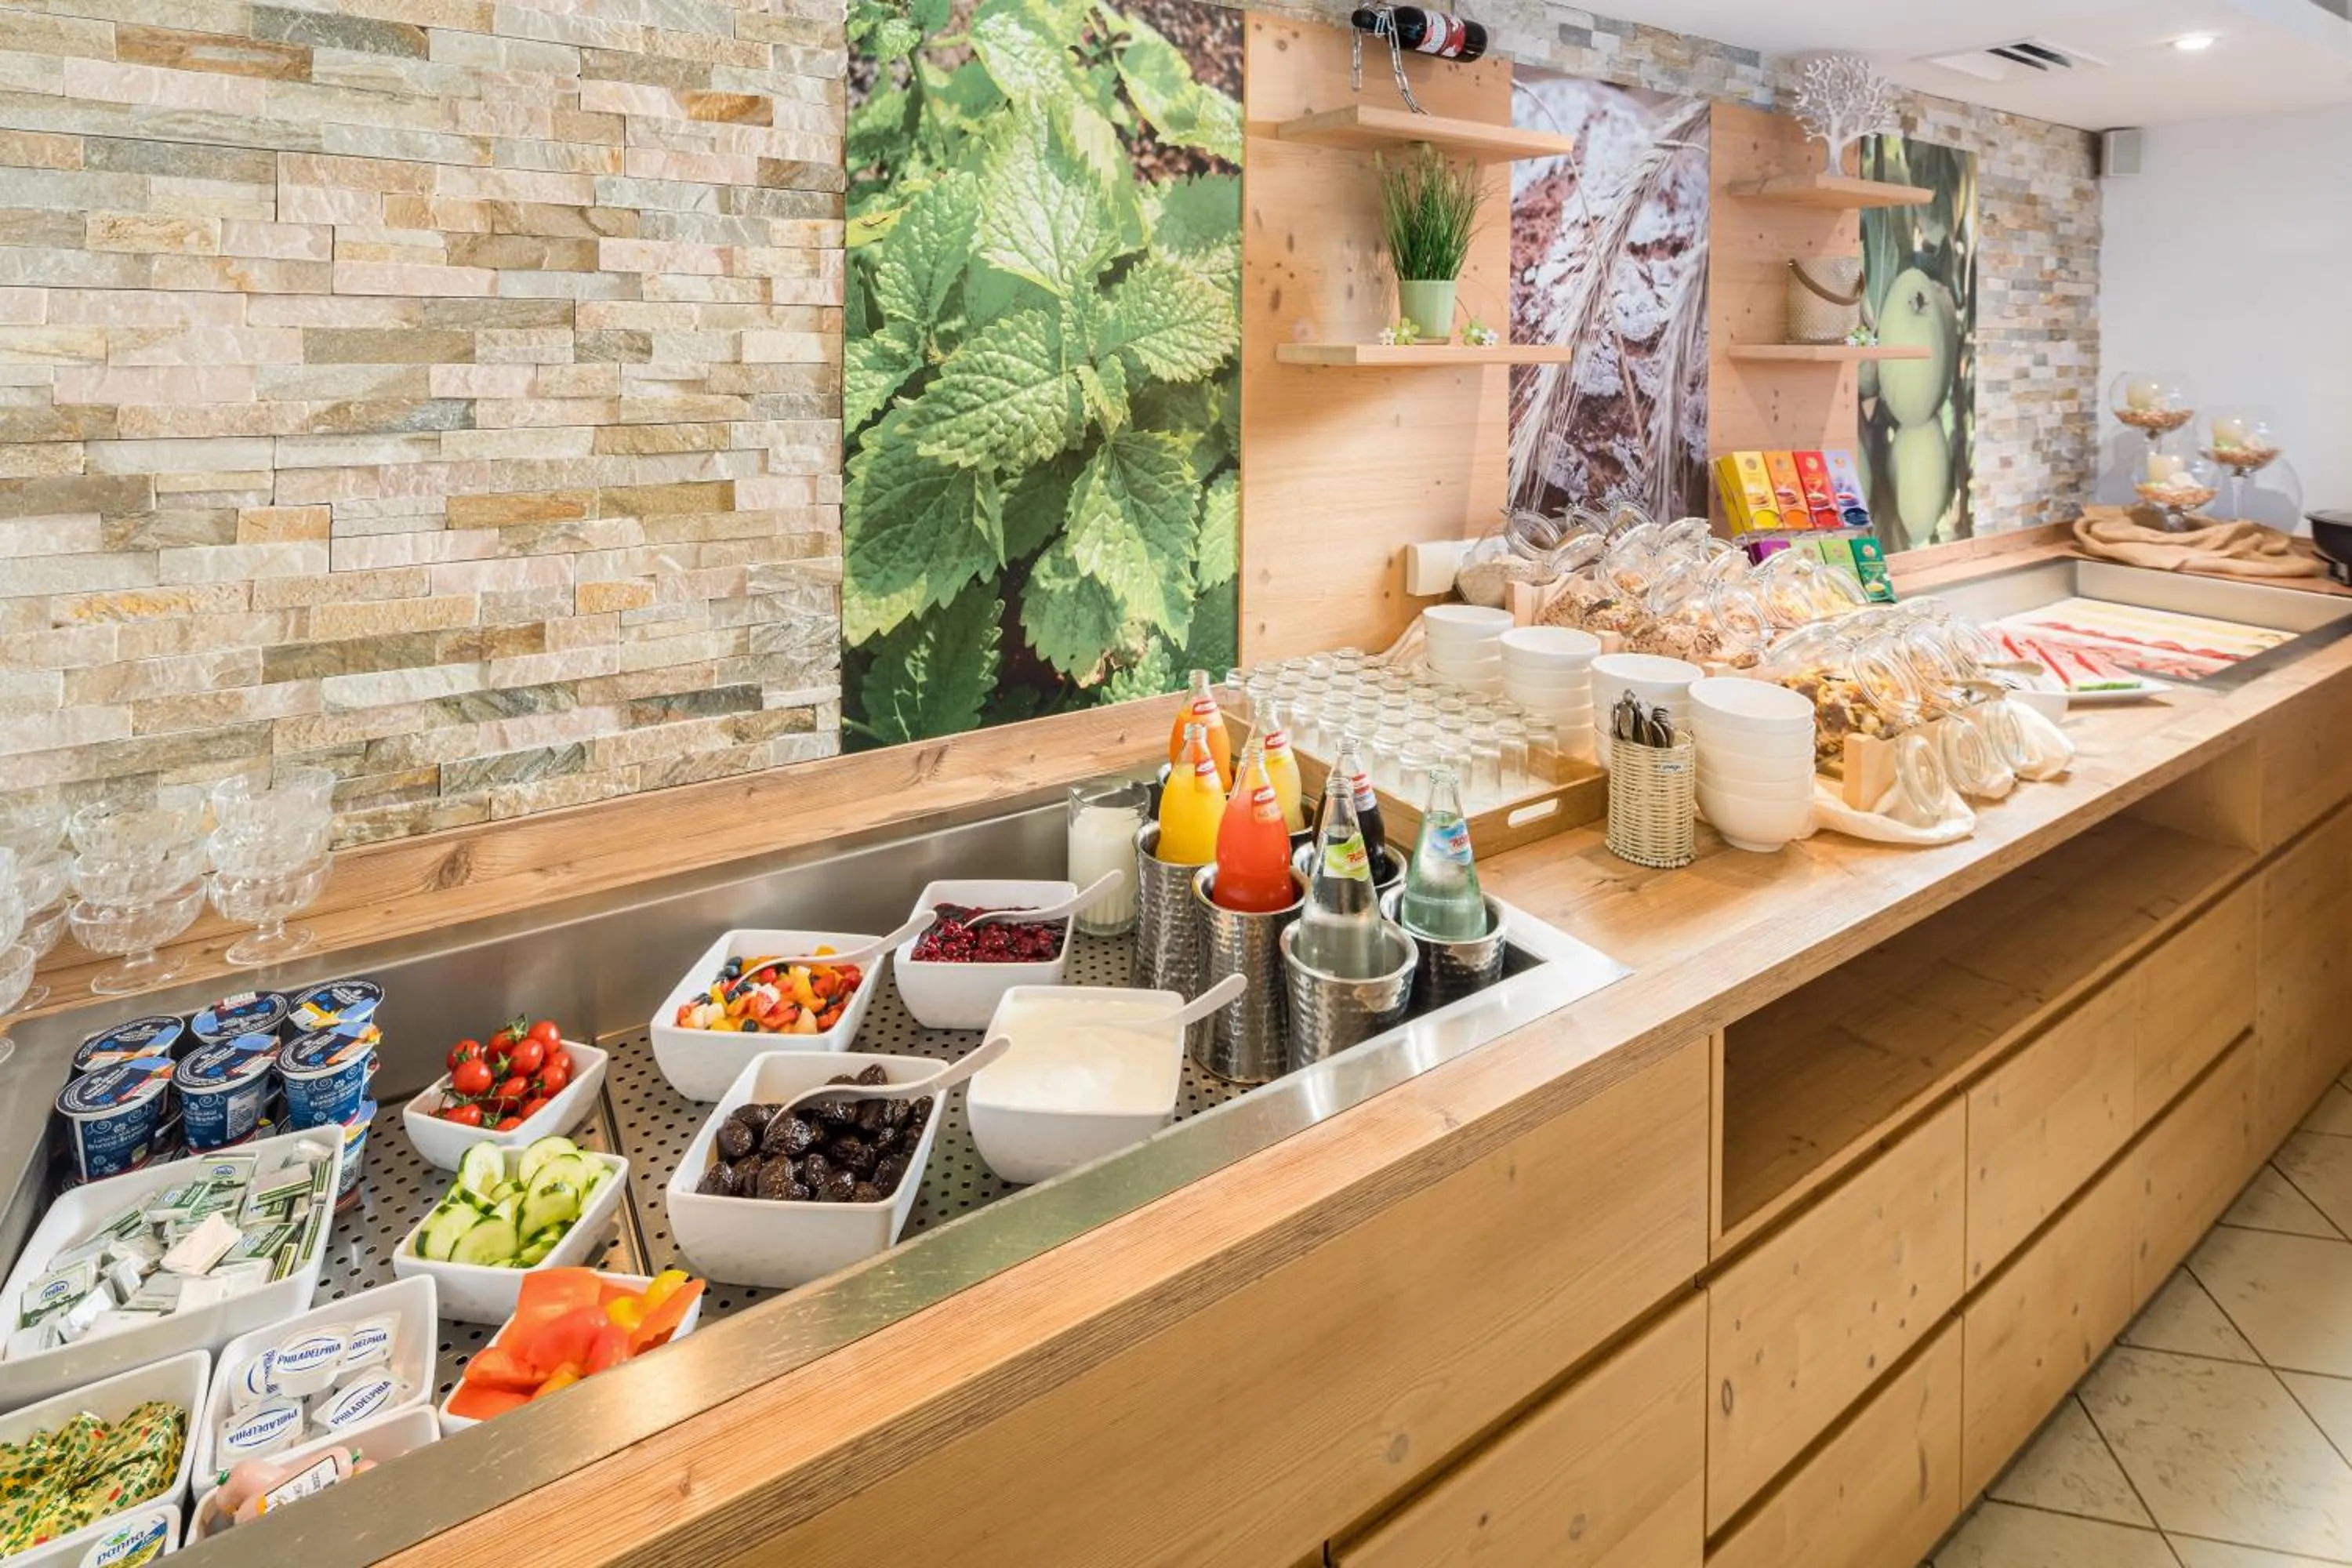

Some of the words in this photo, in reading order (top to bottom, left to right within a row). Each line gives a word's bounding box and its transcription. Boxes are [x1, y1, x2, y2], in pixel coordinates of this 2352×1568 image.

[277, 1342, 342, 1365] PHILADELPHIA
[349, 1332, 387, 1350] DELPHIA
[330, 1380, 392, 1425] PHILADELPHIA
[228, 1408, 299, 1444] PHILADELPHIA
[96, 1530, 145, 1566] panna
